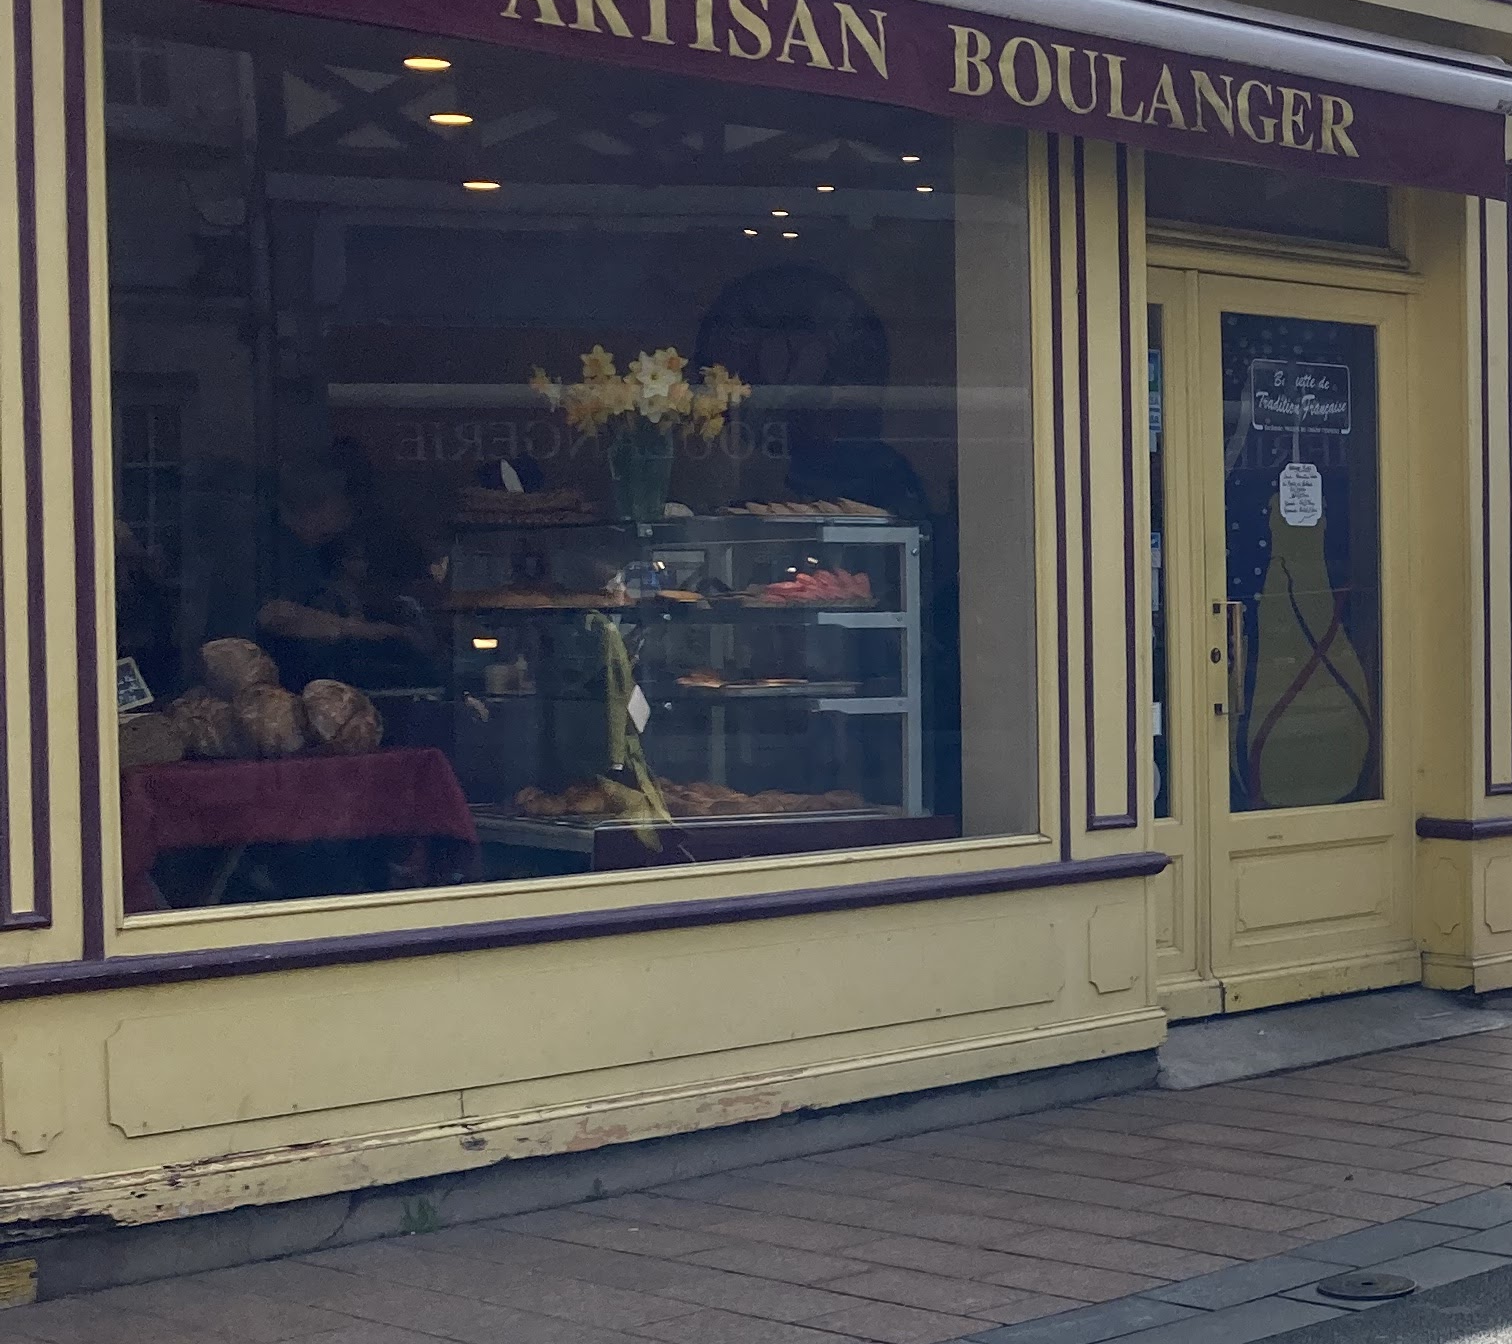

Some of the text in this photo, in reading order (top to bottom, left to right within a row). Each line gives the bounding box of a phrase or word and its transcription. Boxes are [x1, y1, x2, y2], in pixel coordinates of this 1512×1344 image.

[947, 24, 1360, 157] BOULANGER
[1318, 376, 1330, 390] de
[1256, 391, 1300, 416] Tradition
